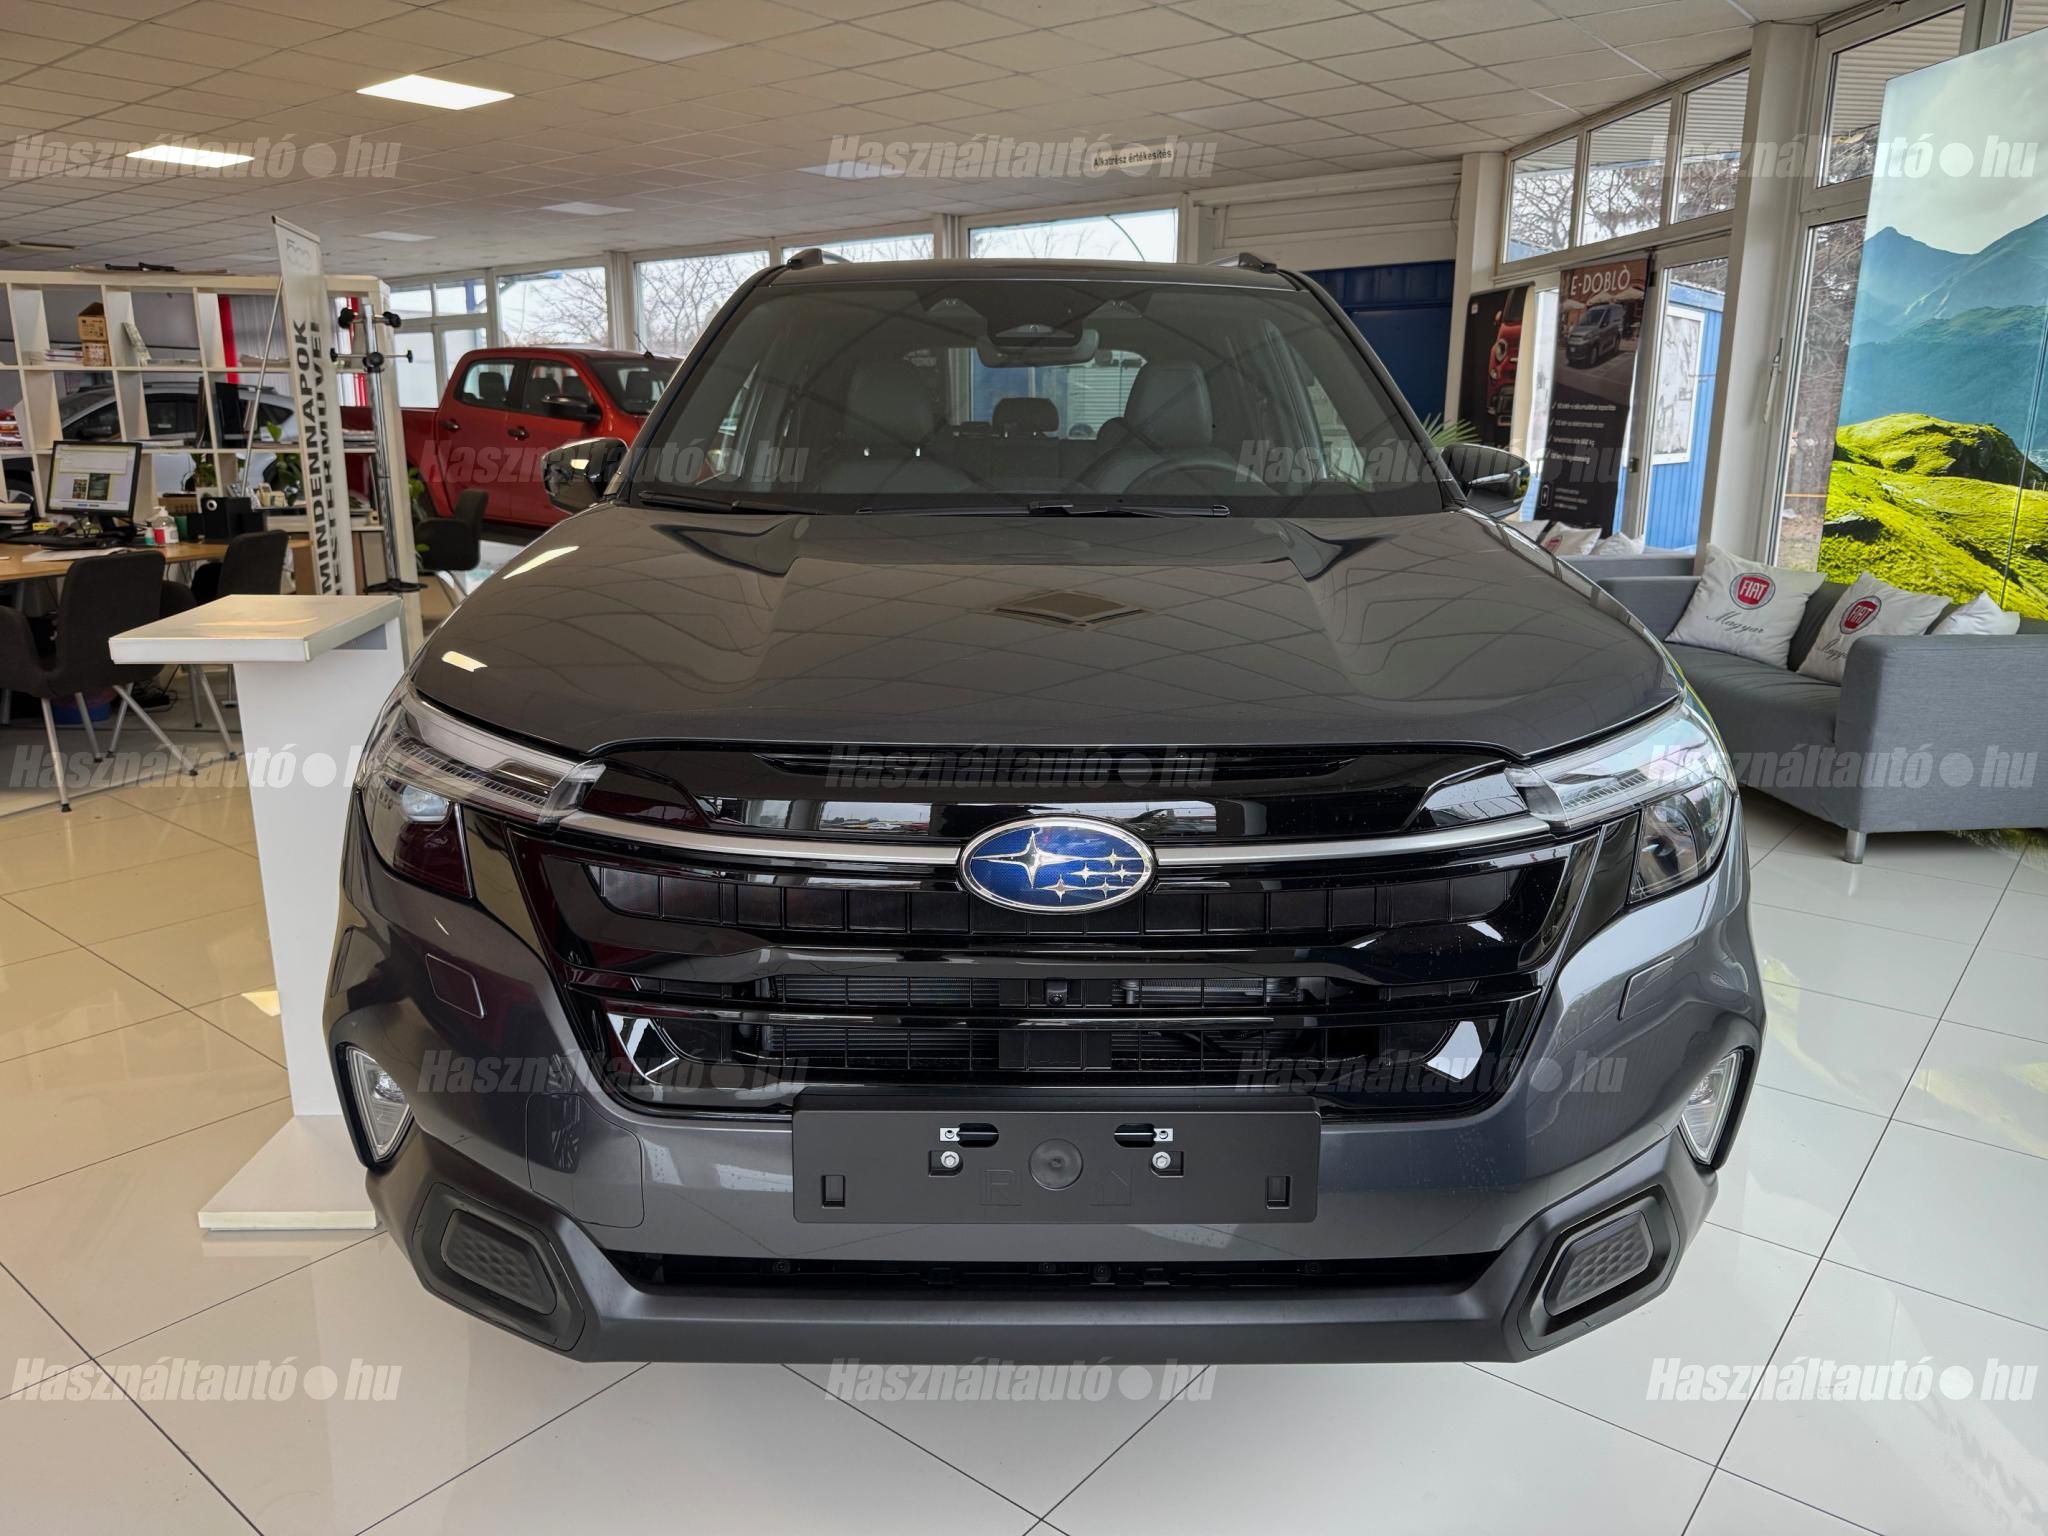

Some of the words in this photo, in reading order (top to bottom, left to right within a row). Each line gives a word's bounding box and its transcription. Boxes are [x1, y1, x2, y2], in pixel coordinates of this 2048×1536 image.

[1570, 264, 1631, 296] E-DOBLÒ
[293, 320, 332, 595] MINDENNAPOK
[1739, 580, 1768, 601] FIAT
[1847, 605, 1874, 625] FIAT
